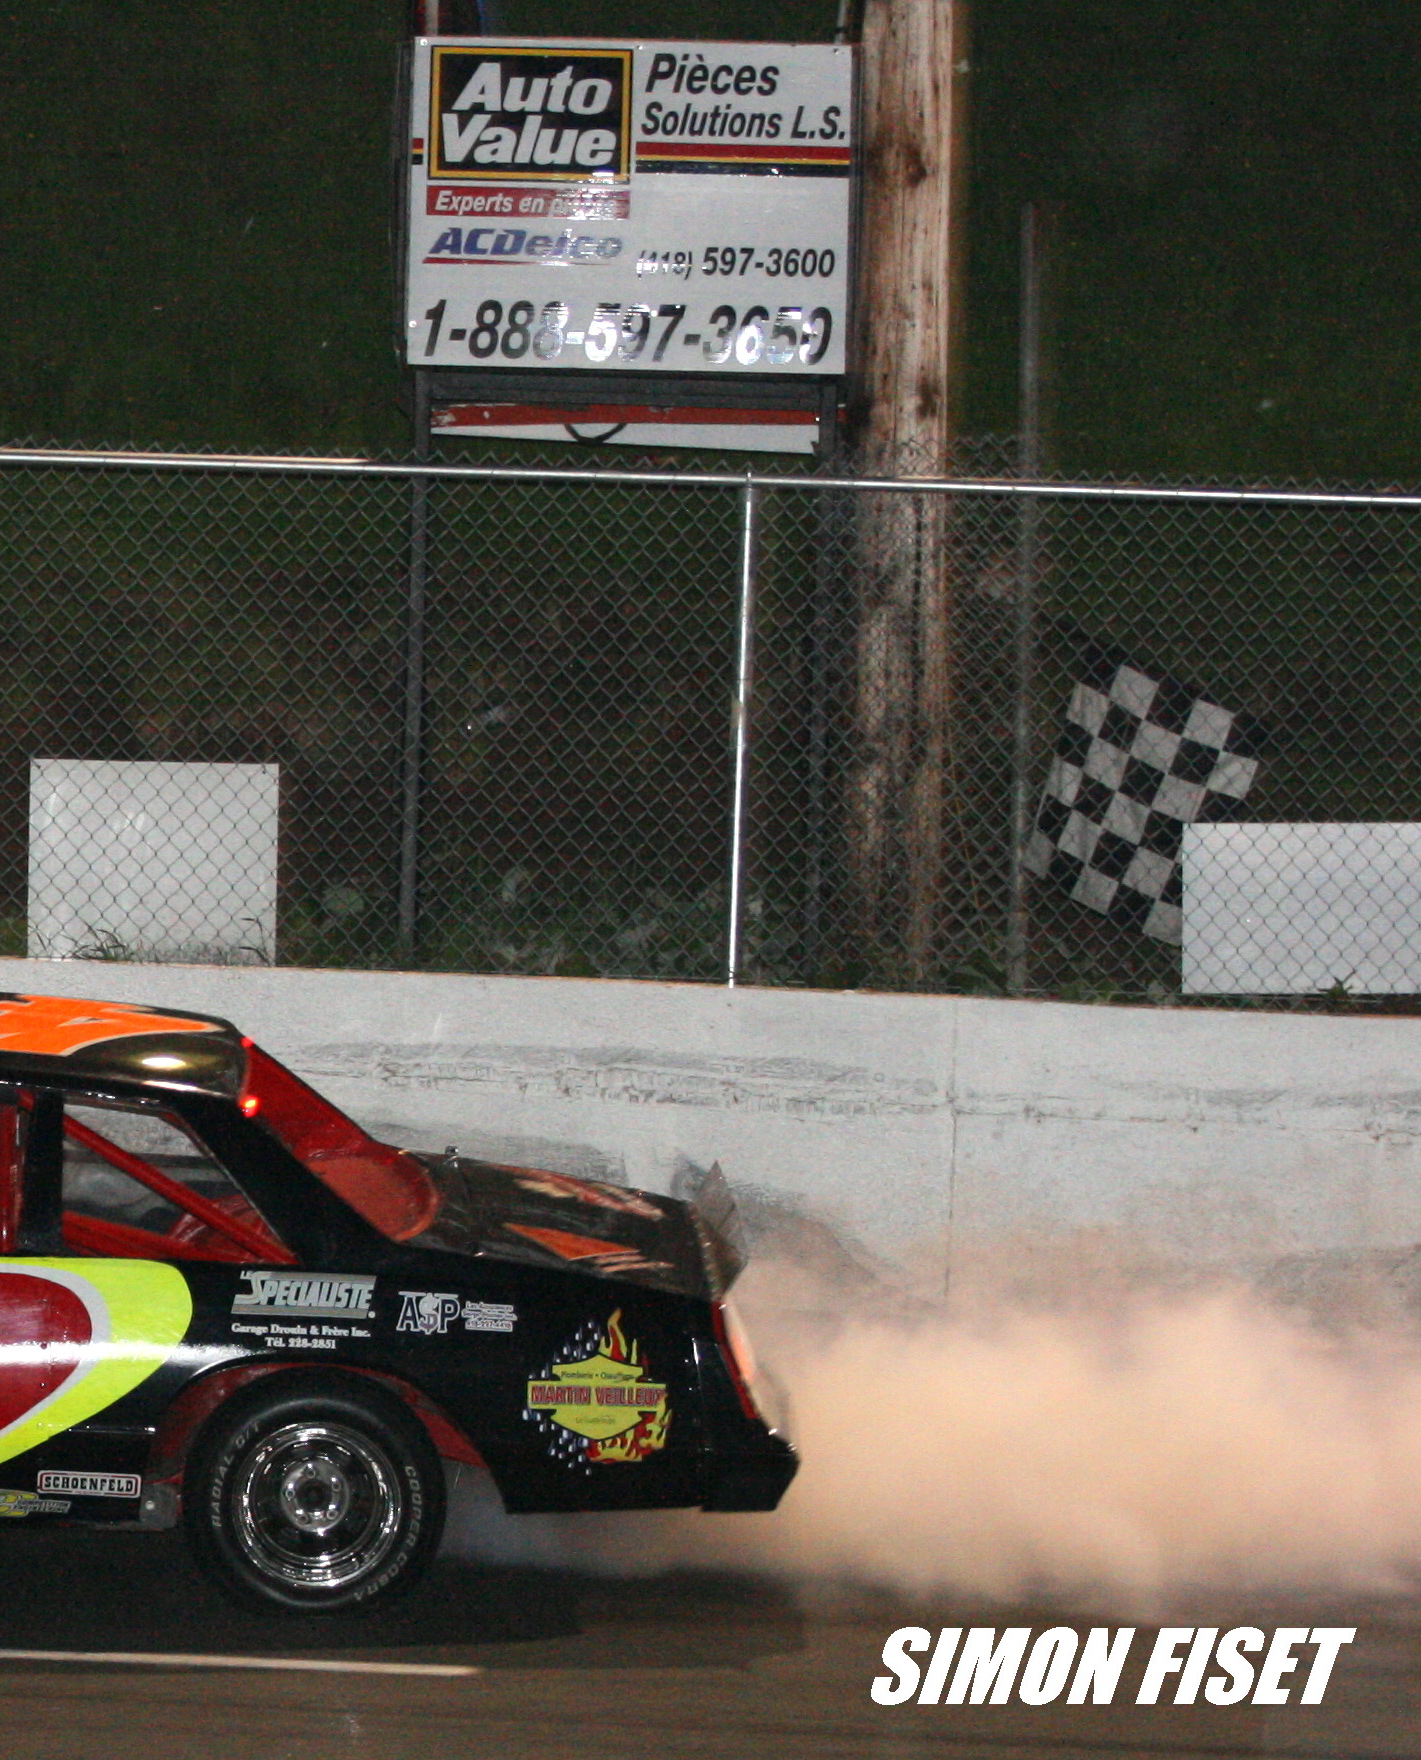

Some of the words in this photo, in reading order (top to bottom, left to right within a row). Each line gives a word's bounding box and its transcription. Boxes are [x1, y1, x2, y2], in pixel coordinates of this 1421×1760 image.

[451, 62, 612, 115] Auto
[645, 53, 780, 96] Pièces
[641, 101, 782, 138] Solutions
[791, 105, 847, 140] L.S.
[442, 114, 617, 166] Value
[435, 190, 515, 215] Experts
[519, 198, 544, 213] en
[702, 247, 835, 277] 597-3600
[425, 299, 832, 365] 1-888-597-3650
[234, 1271, 375, 1309] SPECIALISTE
[231, 1323, 268, 1336] Garage
[270, 1323, 307, 1335] Drouin
[310, 1325, 319, 1335] &
[322, 1325, 350, 1337] Frère
[351, 1327, 371, 1337] Inc.
[265, 1337, 286, 1347] Tél.
[531, 1385, 591, 1405] MARTIN
[595, 1387, 666, 1406] VEILLEUX
[44, 1476, 133, 1492] SCHOENFELD
